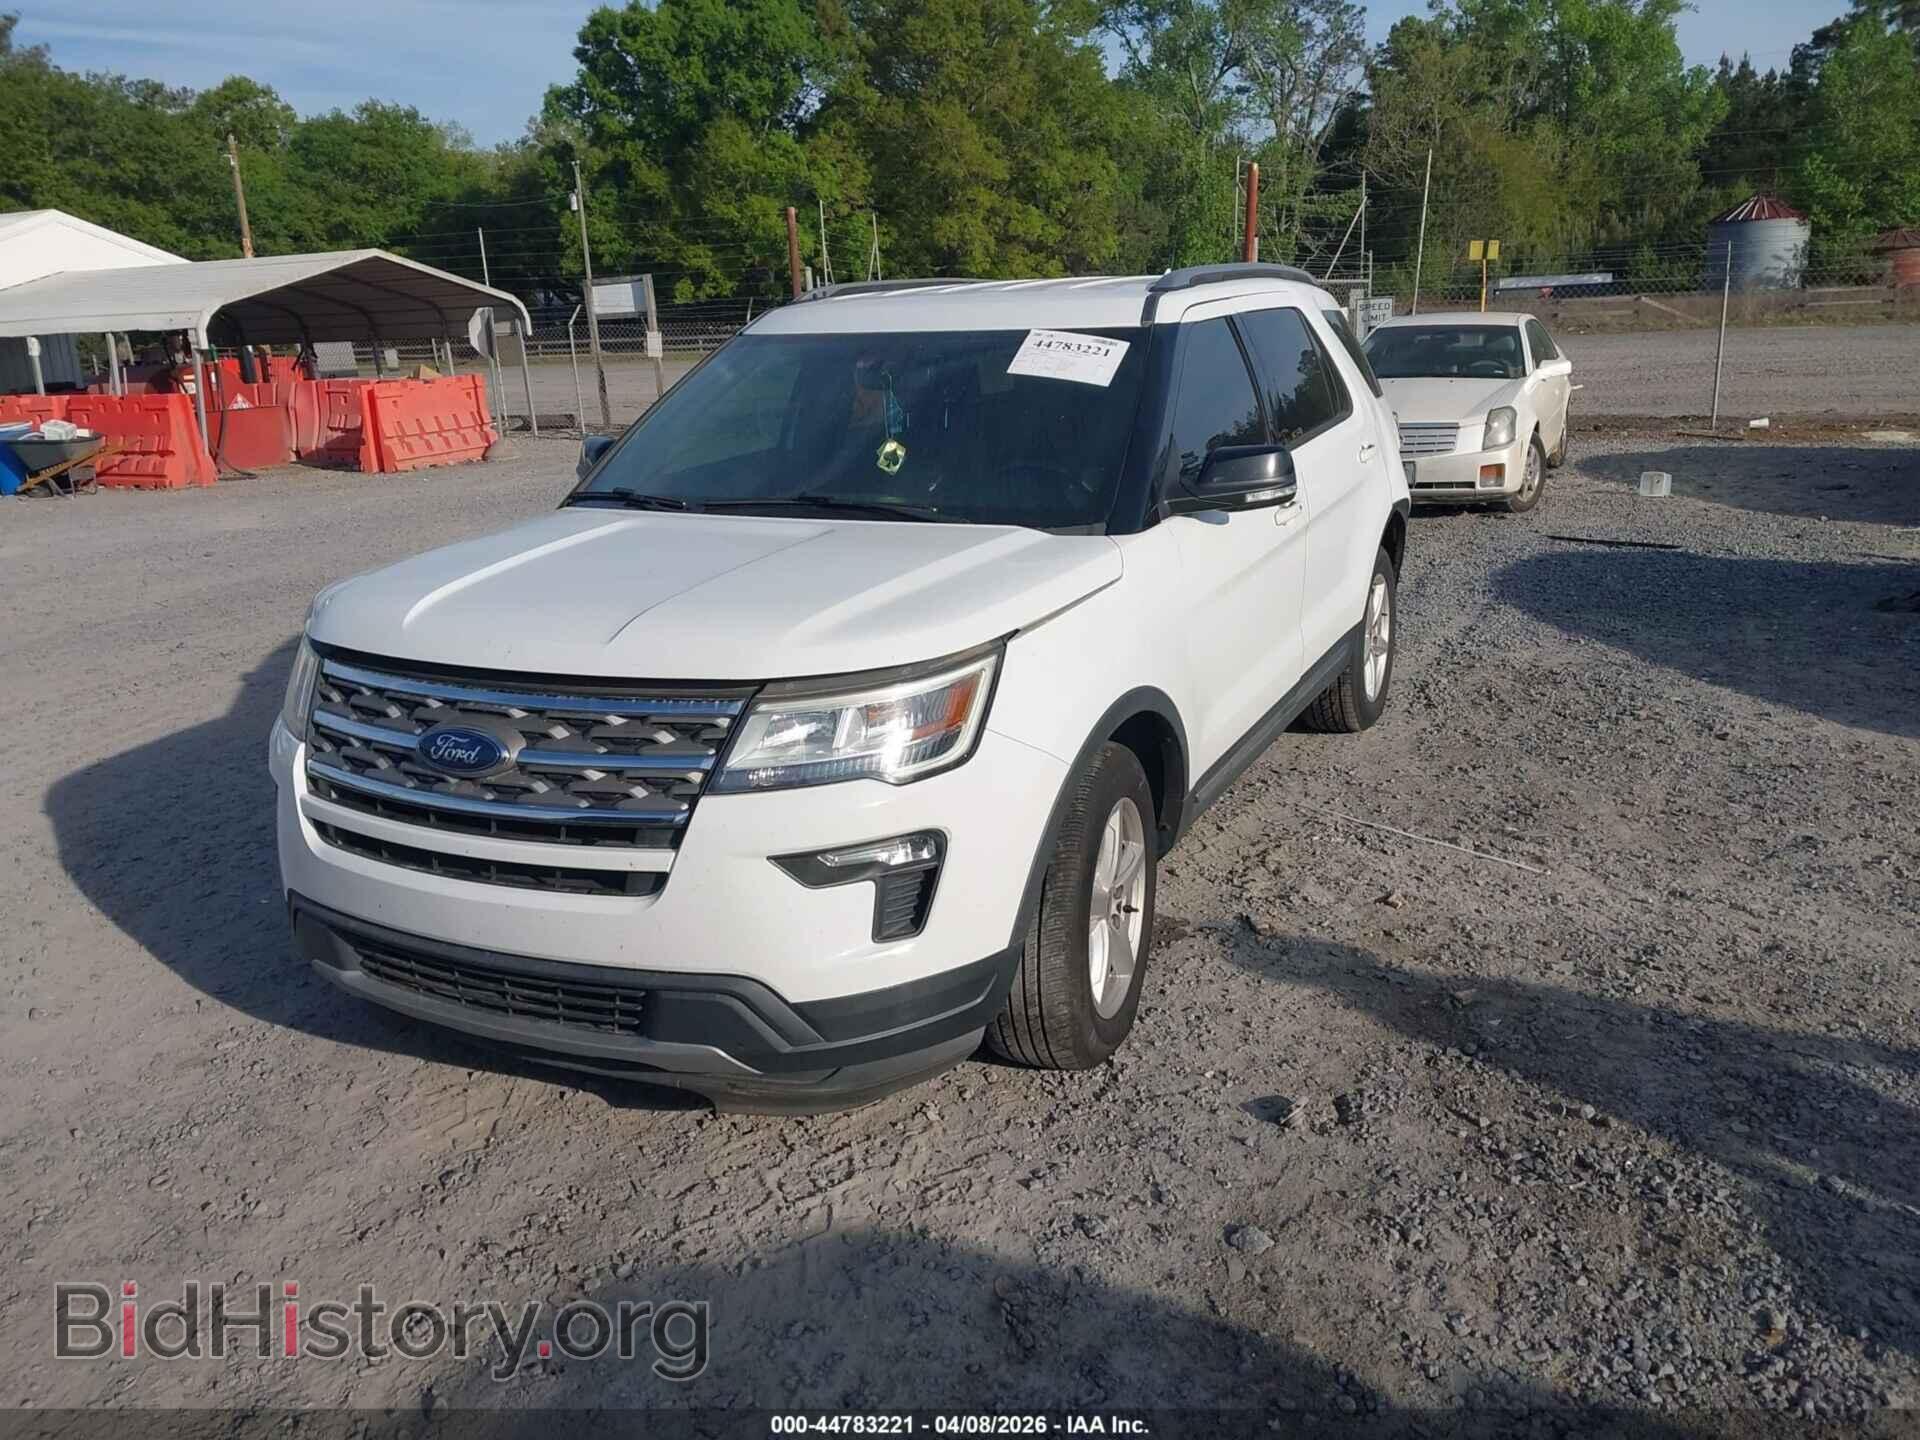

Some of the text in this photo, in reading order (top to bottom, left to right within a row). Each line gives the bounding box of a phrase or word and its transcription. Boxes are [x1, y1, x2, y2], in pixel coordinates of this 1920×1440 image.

[1359, 303, 1391, 311] SPEED
[1361, 314, 1386, 322] LIMIT
[1033, 339, 1111, 357] 44783221
[430, 734, 481, 764] Ford
